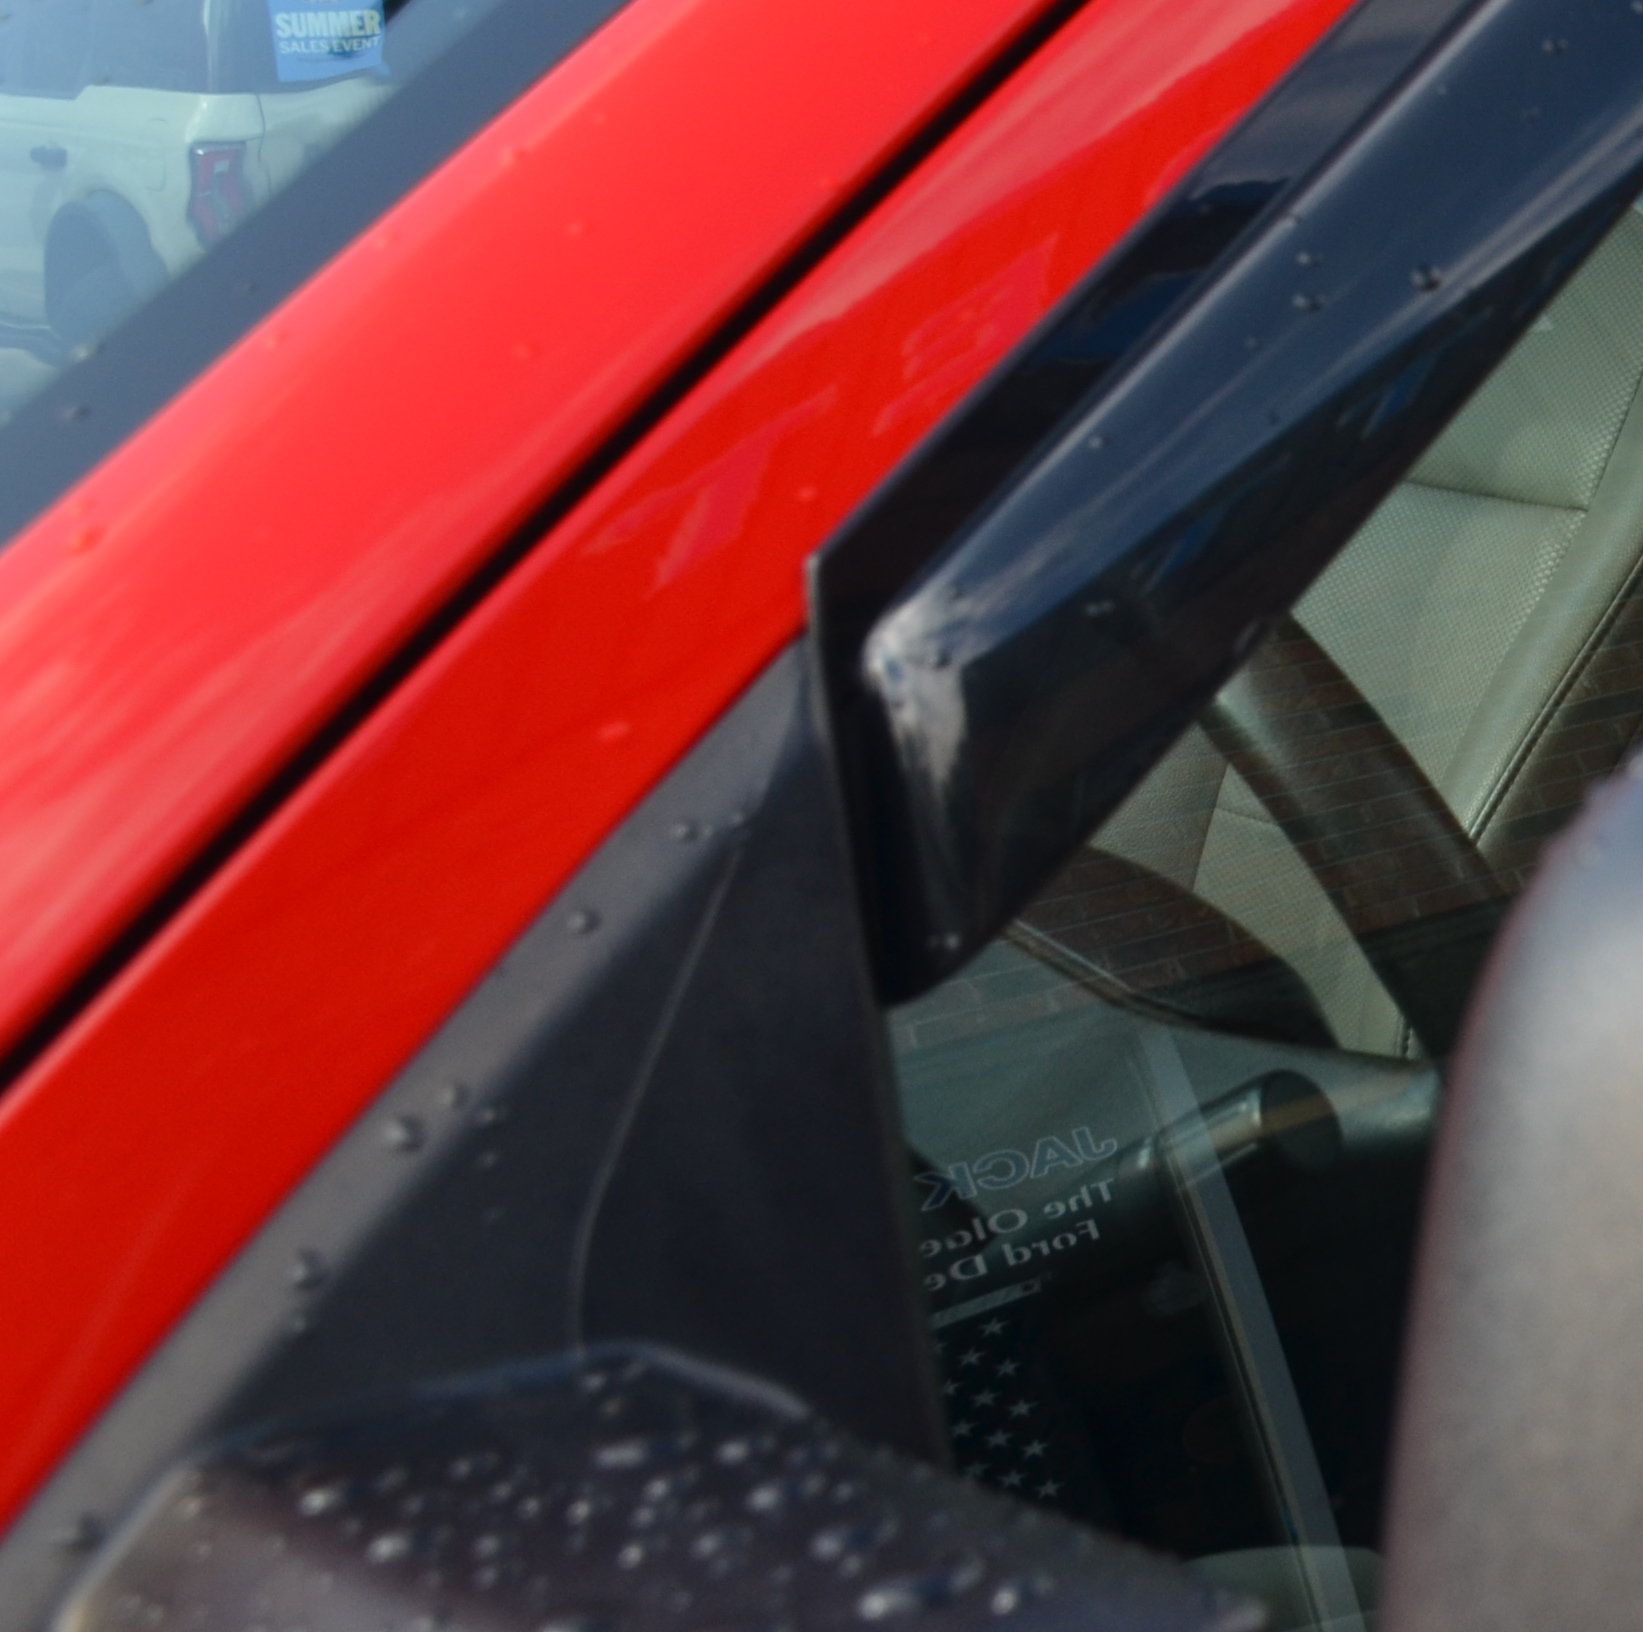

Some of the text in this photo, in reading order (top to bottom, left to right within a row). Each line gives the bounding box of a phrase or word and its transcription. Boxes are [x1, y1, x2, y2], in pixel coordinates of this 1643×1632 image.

[275, 9, 381, 38] SUMMER
[278, 36, 382, 54] SALES EVENT
